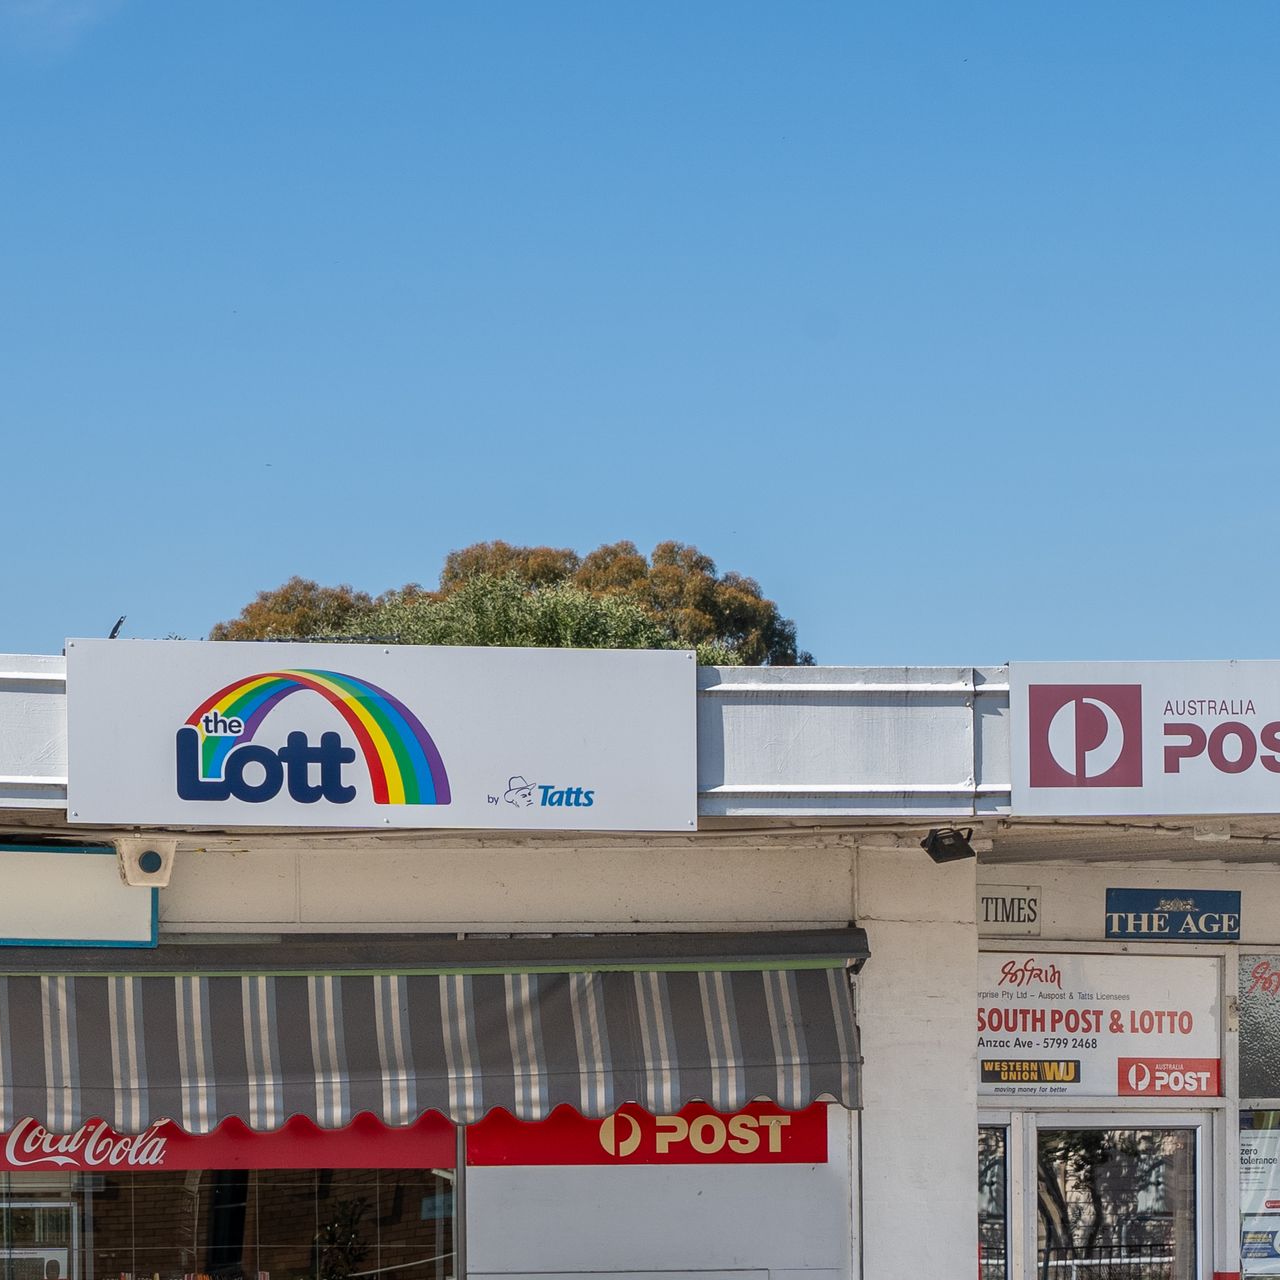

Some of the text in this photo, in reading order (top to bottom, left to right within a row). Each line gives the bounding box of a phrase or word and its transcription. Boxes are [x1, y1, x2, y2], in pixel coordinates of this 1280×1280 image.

[1163, 699, 1256, 716] AUSTRALIA
[202, 712, 242, 734] the
[176, 727, 356, 804] Lott
[487, 784, 595, 807] by Tatts
[981, 897, 1038, 923] TIMES
[1106, 912, 1240, 934] THE AGE
[1002, 990, 1013, 1001] Pty
[1016, 991, 1027, 999] Ltd
[1038, 991, 1066, 1001] Auspost
[1069, 992, 1074, 1000] &
[1078, 992, 1094, 1000] Tatts
[1096, 992, 1130, 1001] Licensees
[977, 1007, 1194, 1035] SOUTH POST & LOTTO
[977, 1036, 1011, 1048] Anzac
[1013, 1037, 1033, 1048] Ave
[1043, 1037, 1068, 1049] 5799
[1071, 1038, 1098, 1049] 2468
[983, 1061, 1038, 1071] WESTERN
[1155, 1063, 1184, 1071] AUSTRALIA
[1001, 1071, 1038, 1081] UNION
[1155, 1071, 1211, 1092] POST
[994, 1086, 1016, 1094] moving
[1017, 1086, 1037, 1094] money
[656, 1114, 791, 1154] POST
[1240, 1148, 1258, 1156] zero
[1240, 1156, 1278, 1165] tolerance
